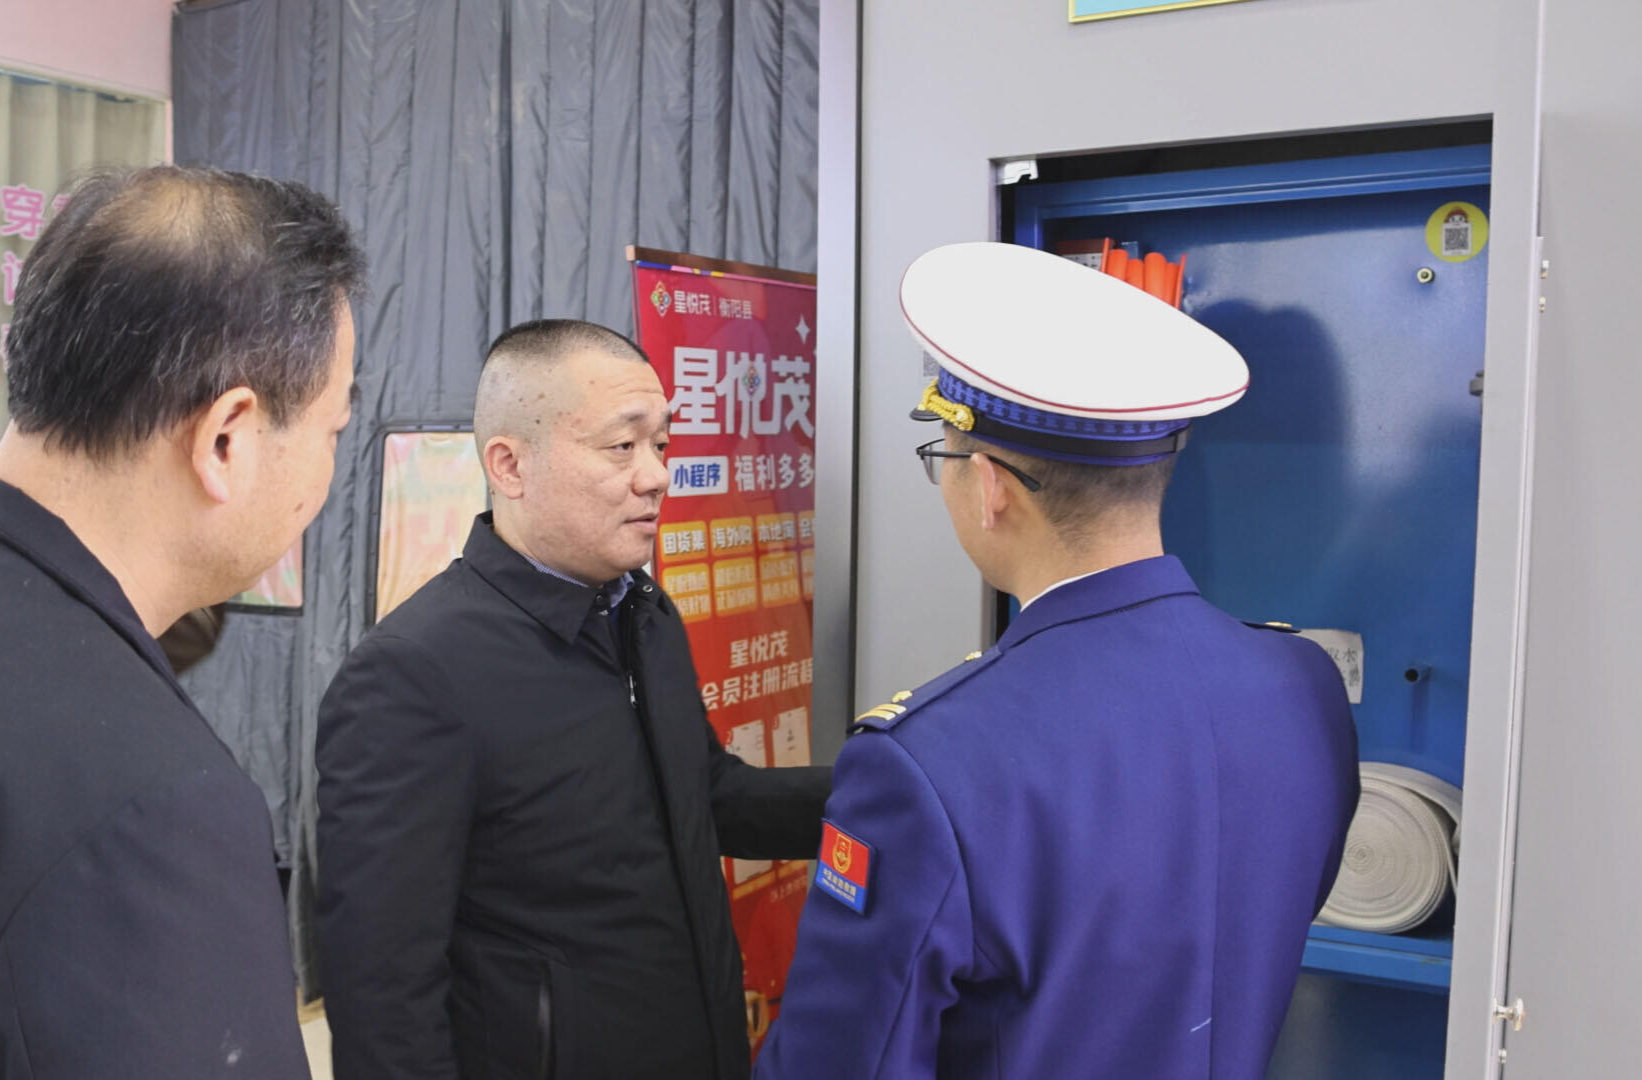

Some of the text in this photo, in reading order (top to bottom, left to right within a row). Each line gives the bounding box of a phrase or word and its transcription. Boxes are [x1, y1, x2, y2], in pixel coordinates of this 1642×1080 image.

[673, 290, 712, 316] 星悦茂
[669, 346, 815, 439] 星悦茂
[674, 453, 815, 492] 小程序 福利多多
[729, 630, 789, 669] 星悦茂
[701, 657, 814, 711] 会员注册流程
